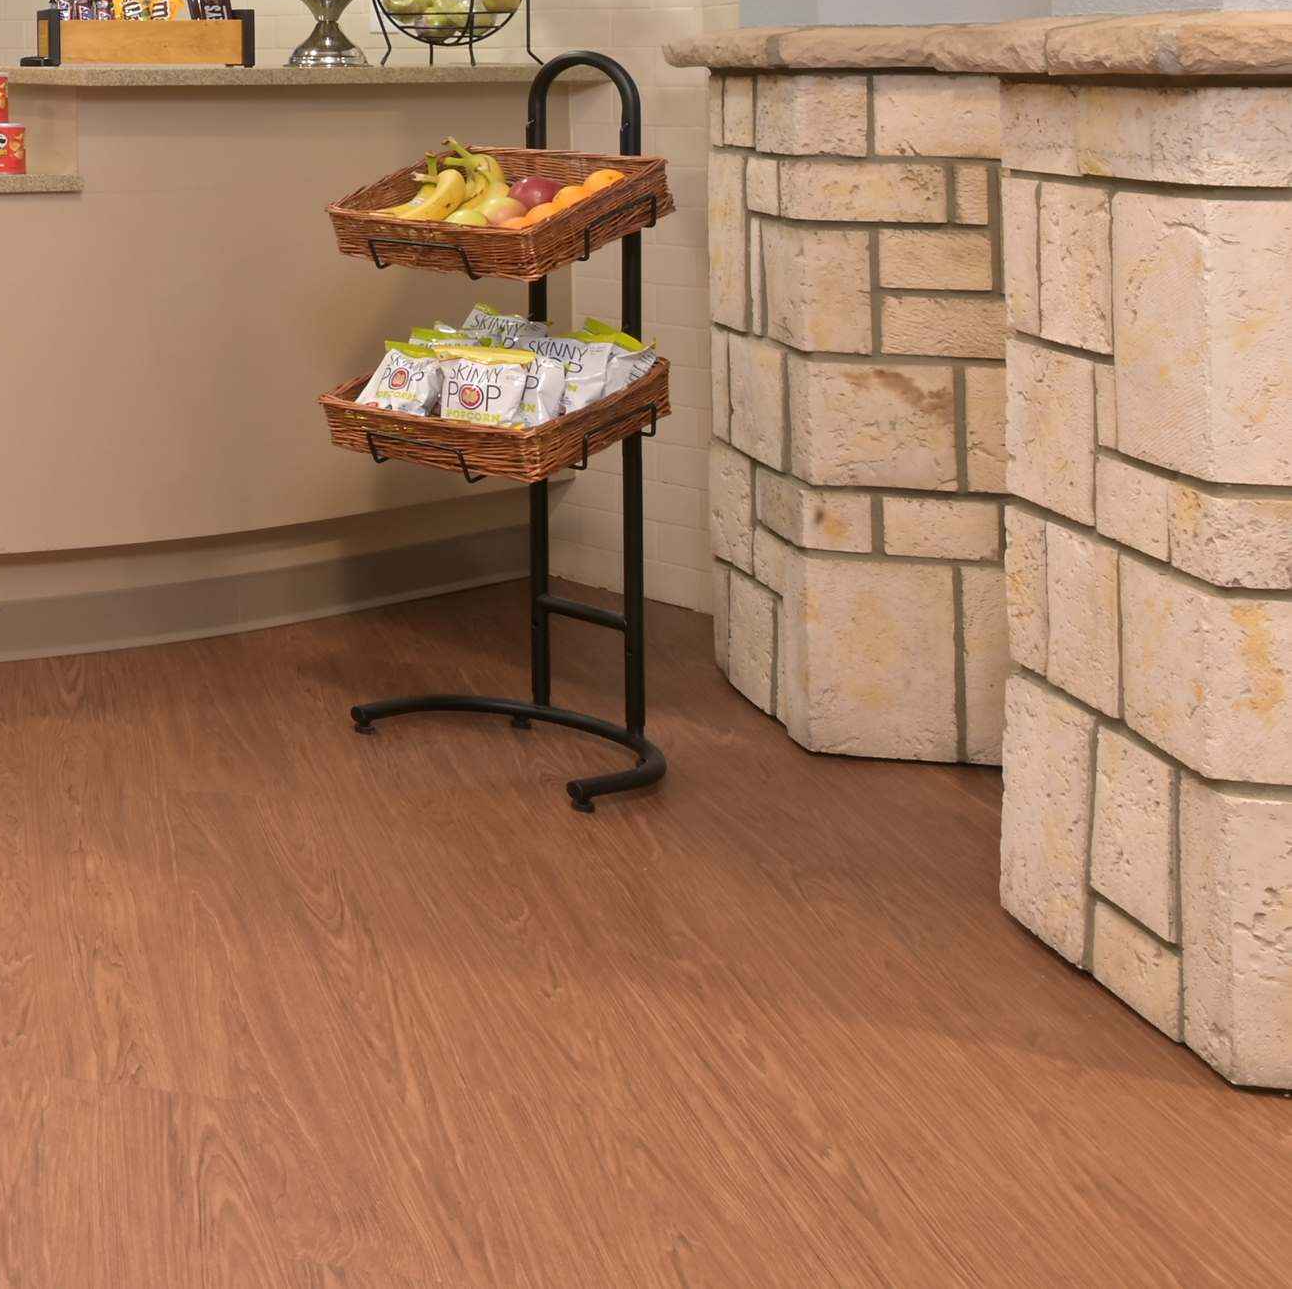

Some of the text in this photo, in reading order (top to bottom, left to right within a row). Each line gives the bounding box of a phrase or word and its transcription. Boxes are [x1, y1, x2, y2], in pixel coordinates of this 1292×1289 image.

[474, 314, 526, 337] SKINNY
[528, 340, 588, 361] SKINNY
[381, 363, 424, 392] POP
[449, 362, 503, 384] SKINNY
[446, 381, 502, 412] POP
